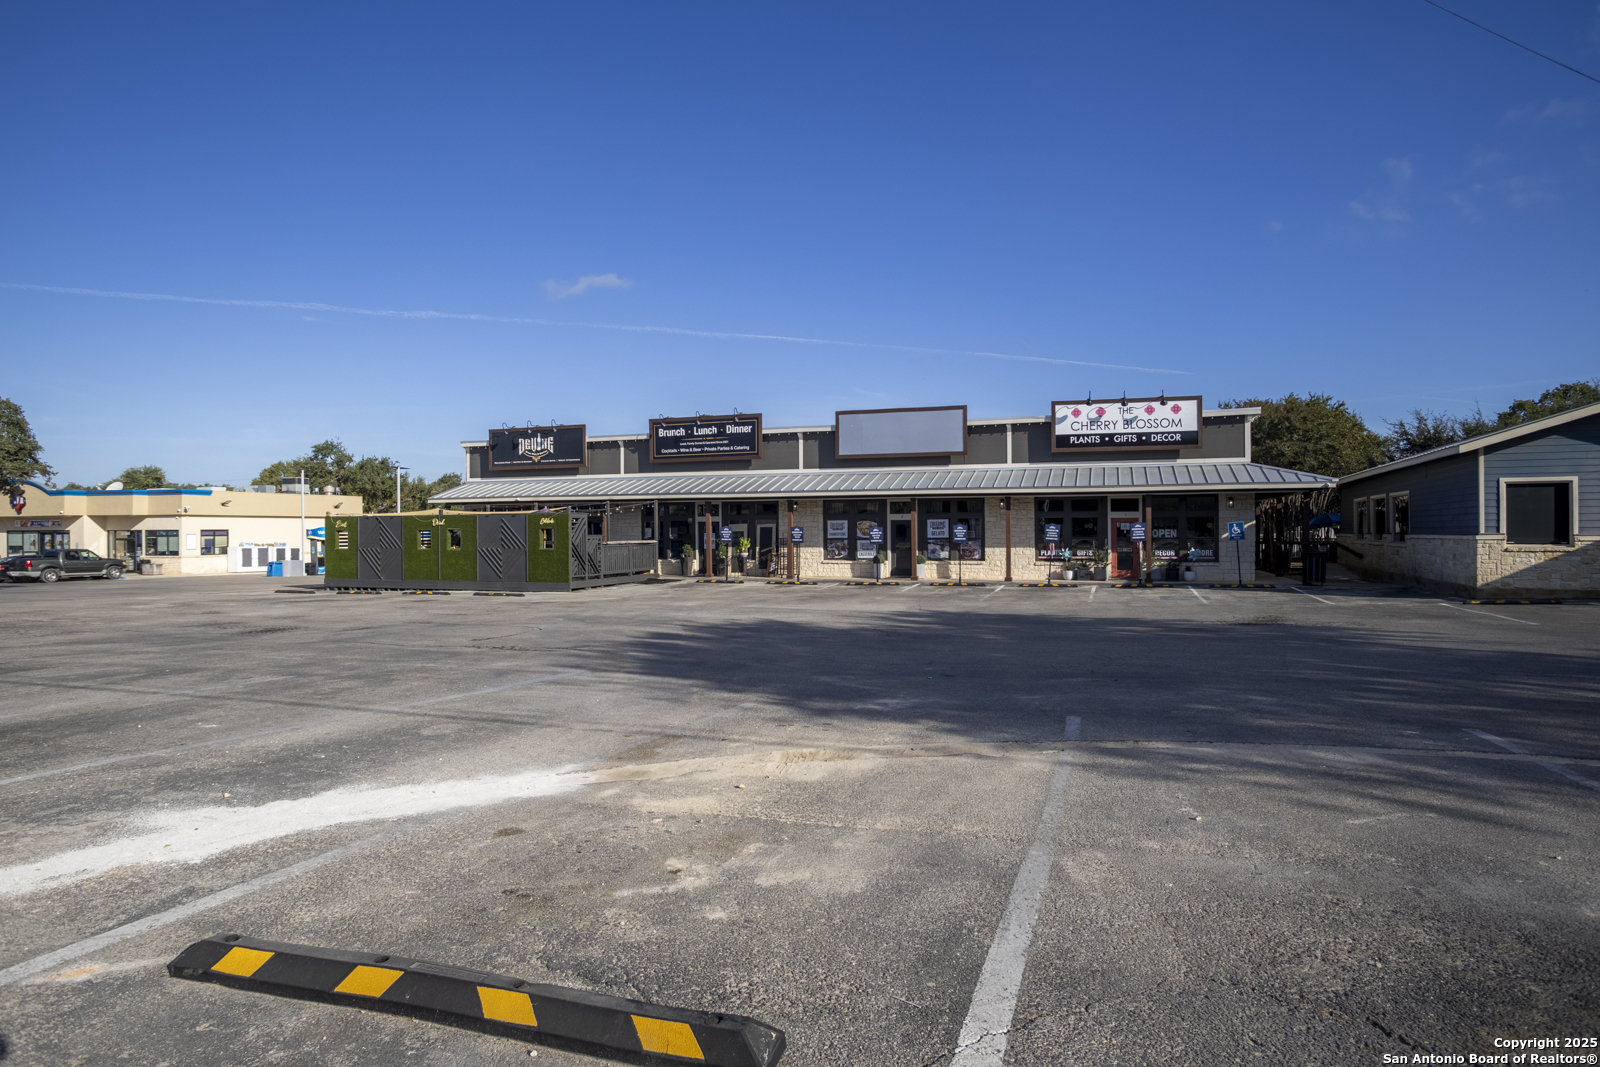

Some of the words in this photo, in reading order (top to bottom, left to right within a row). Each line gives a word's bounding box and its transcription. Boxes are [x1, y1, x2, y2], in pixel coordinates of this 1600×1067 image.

[1117, 406, 1134, 415] THE
[1070, 420, 1119, 432] CHERRY
[1122, 417, 1183, 430] BLOSSOM
[658, 427, 686, 438] Brunch
[693, 425, 718, 436] Lunch
[726, 424, 753, 435] Dinner
[1070, 435, 1101, 444] PLANTS
[1114, 434, 1138, 443] GIFTS
[1151, 433, 1182, 442] DECOR
[1152, 529, 1178, 538] OPEN
